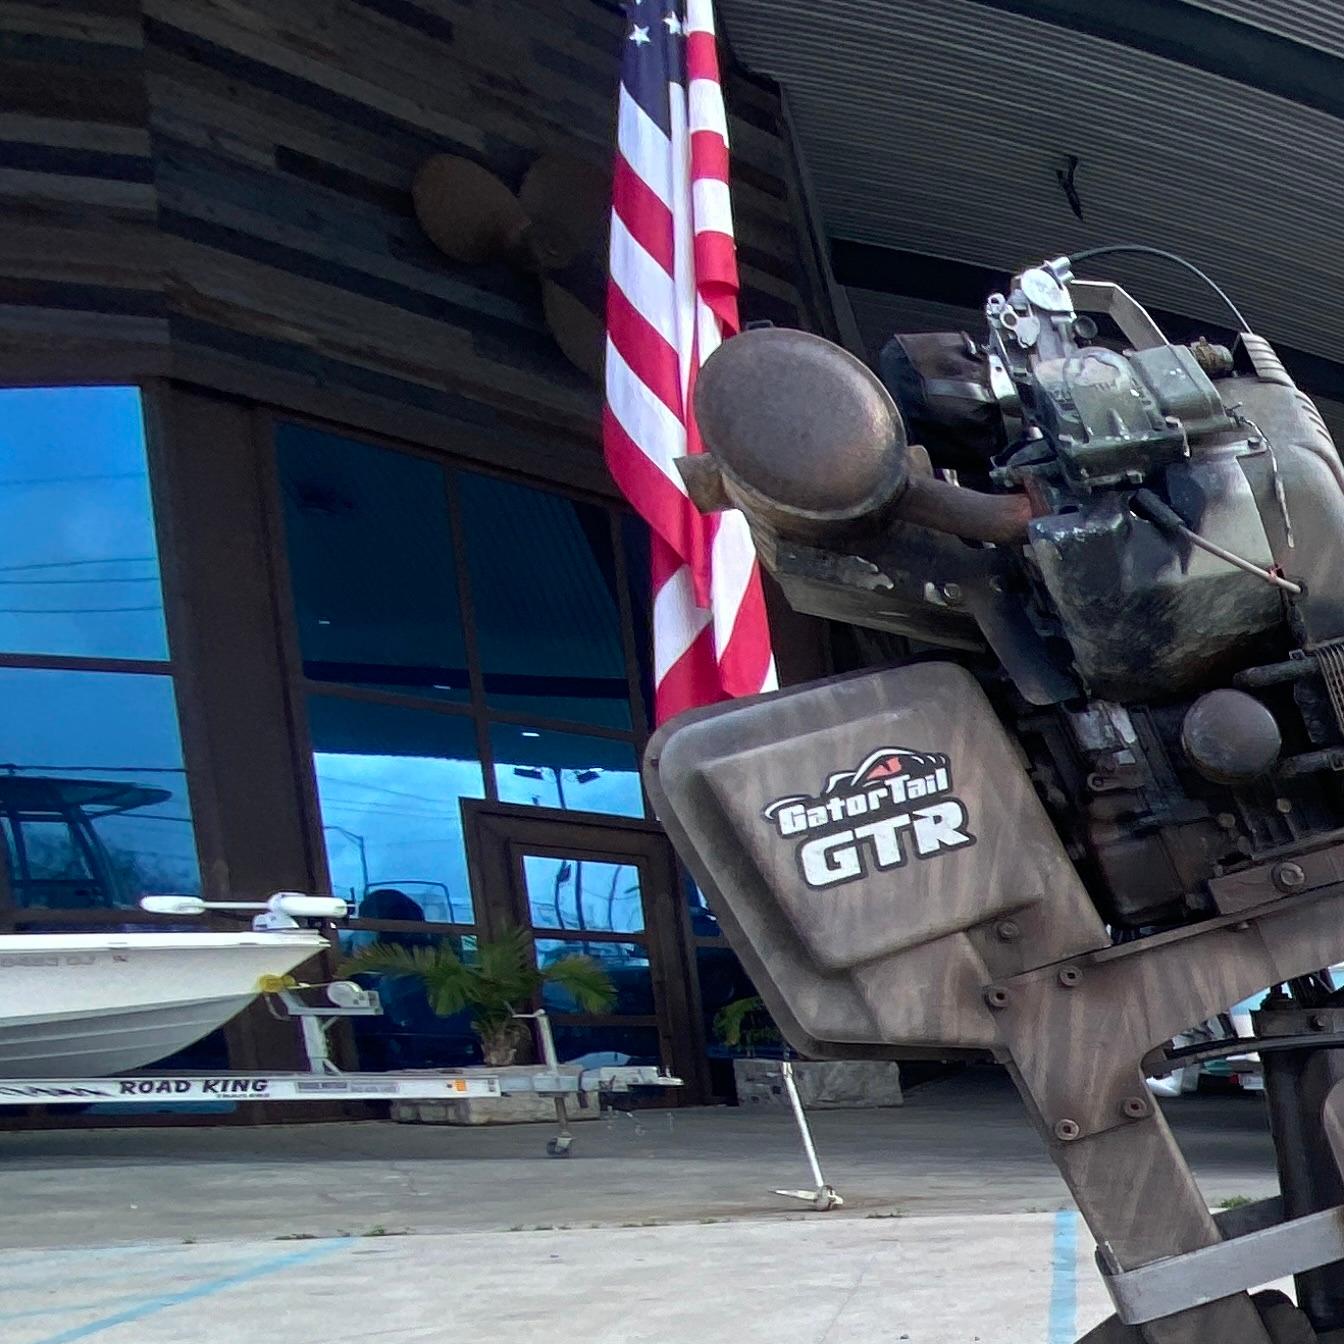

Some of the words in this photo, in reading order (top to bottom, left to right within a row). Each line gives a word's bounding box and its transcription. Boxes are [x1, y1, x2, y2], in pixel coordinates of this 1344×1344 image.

[778, 767, 950, 836] GatorTail
[800, 801, 970, 887] GTR
[119, 1080, 191, 1095] ROAD
[202, 1078, 270, 1094] KING
